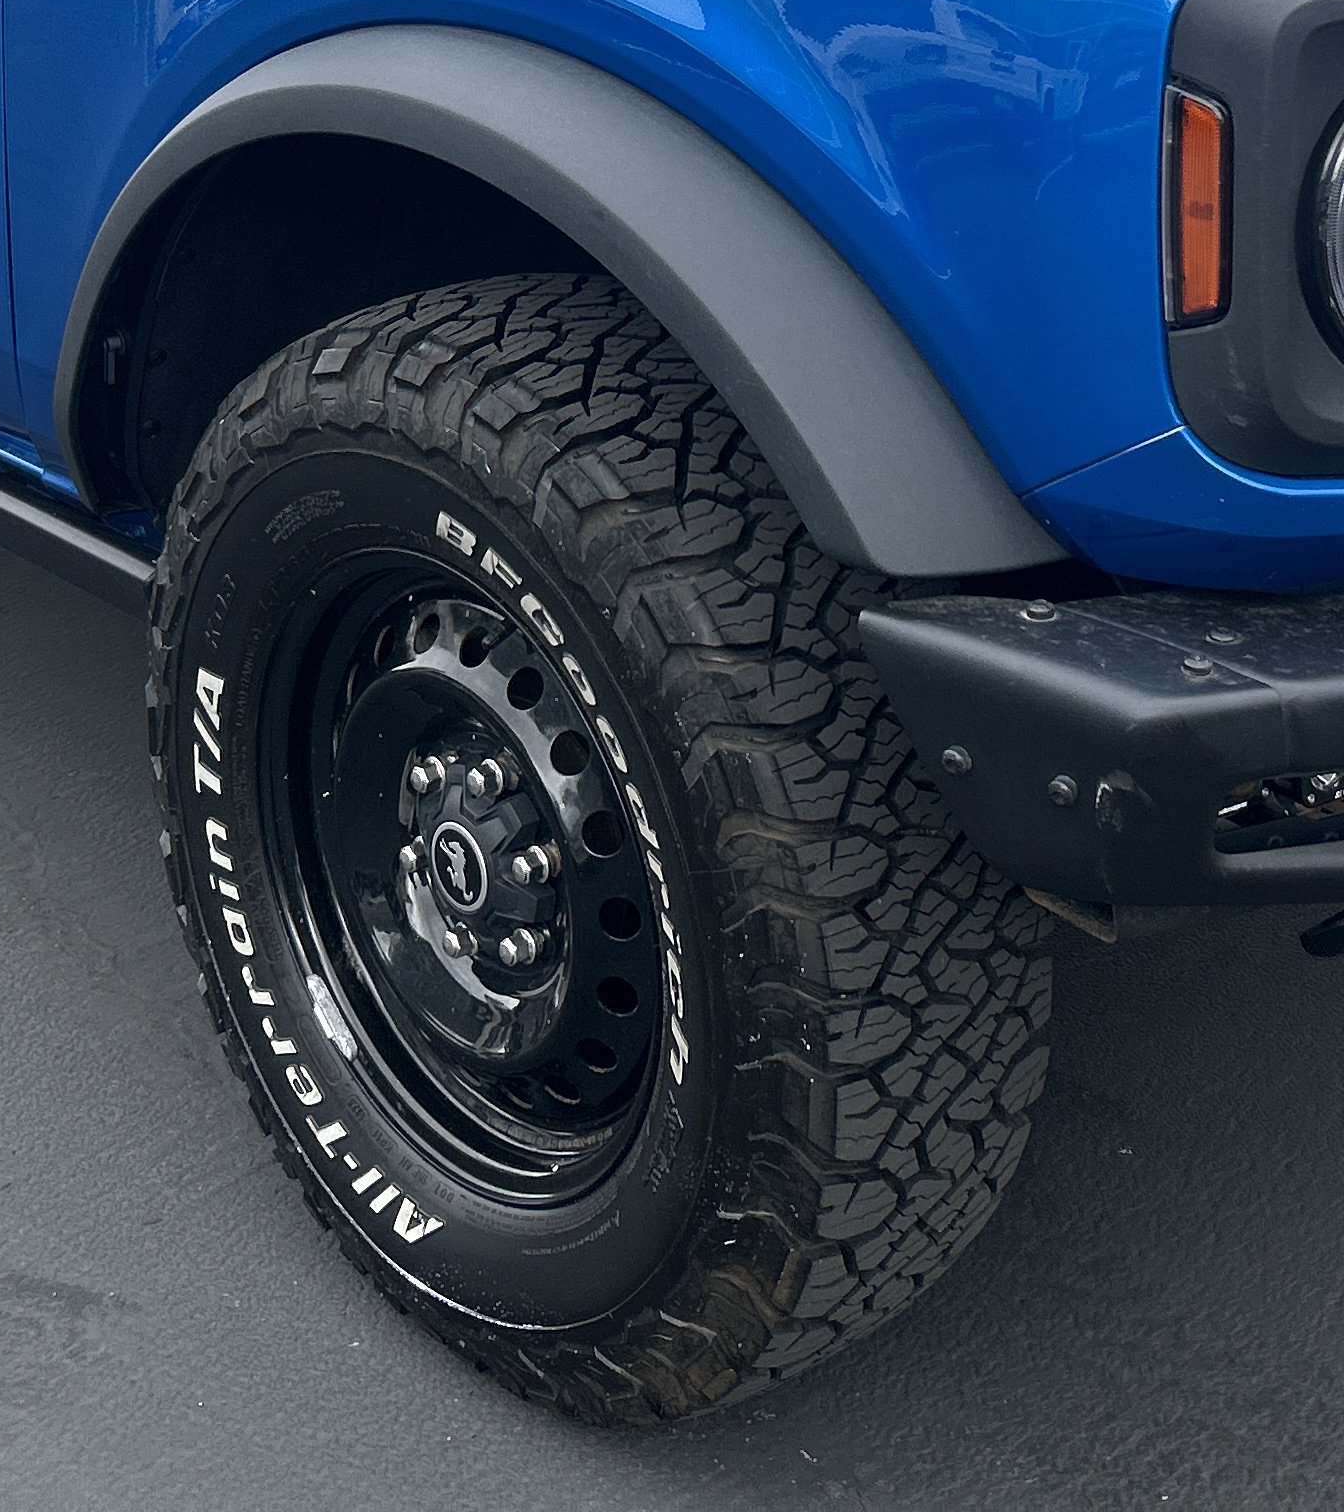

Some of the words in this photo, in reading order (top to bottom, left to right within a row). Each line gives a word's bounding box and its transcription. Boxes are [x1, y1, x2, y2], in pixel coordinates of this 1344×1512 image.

[194, 667, 225, 795] T/A
[436, 510, 689, 1085] BFGoodrich
[206, 816, 444, 1243] All-Terrain
